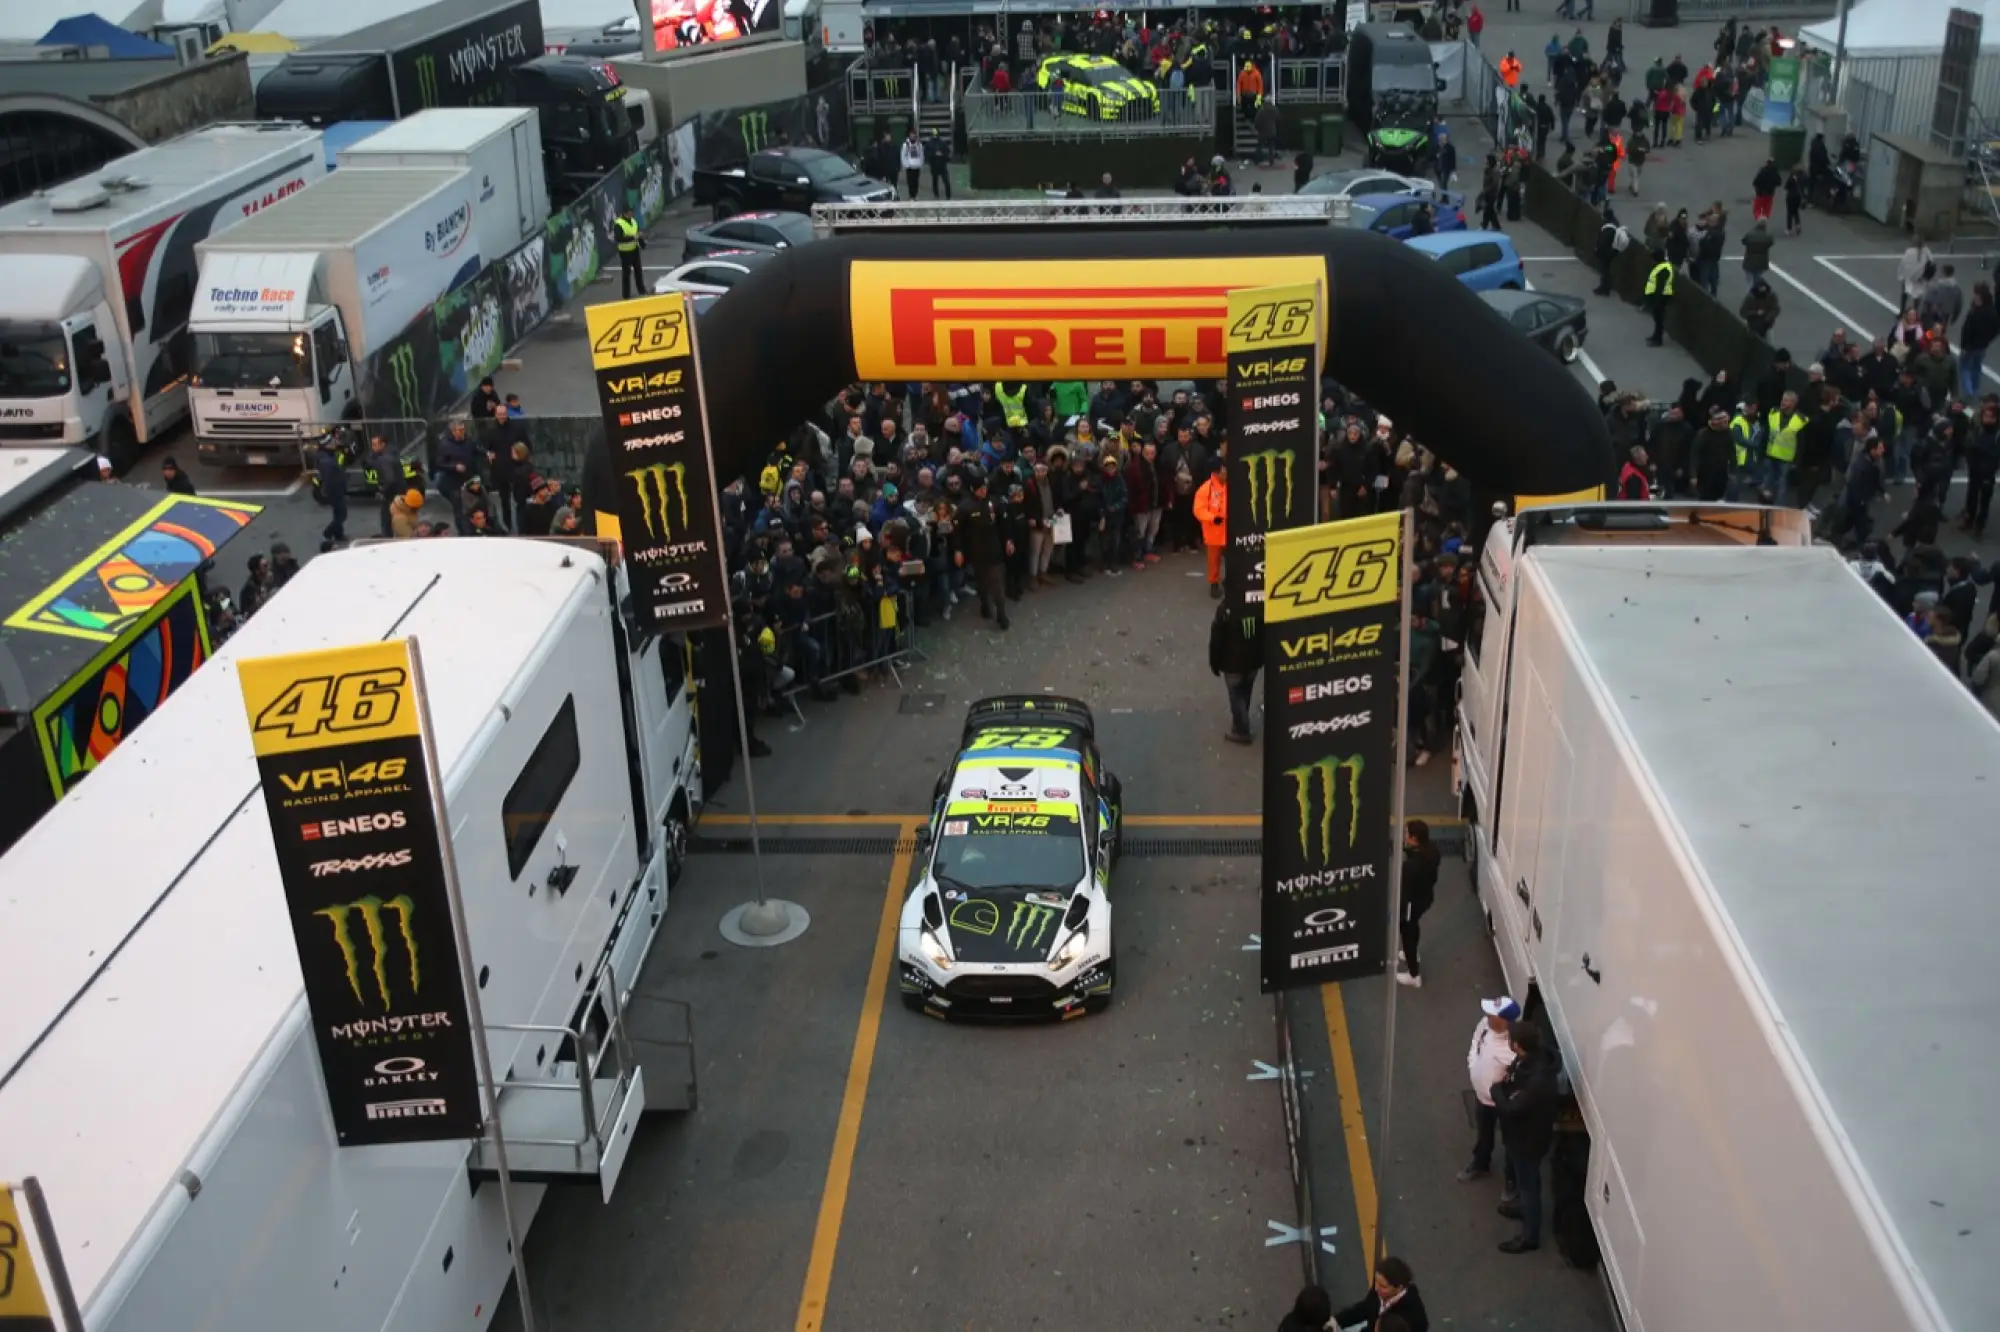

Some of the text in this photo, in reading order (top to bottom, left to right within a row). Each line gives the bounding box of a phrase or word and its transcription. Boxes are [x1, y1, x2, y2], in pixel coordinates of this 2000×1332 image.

[449, 24, 527, 85] MONSTER
[211, 287, 296, 302] Techno Race
[260, 304, 284, 312] rent
[1230, 299, 1314, 342] 46
[594, 311, 683, 358] 46
[890, 286, 1227, 367] PIRELL
[235, 403, 273, 412] BIANCHI
[1253, 392, 1301, 410] ENEOS
[631, 404, 682, 425] ENEOS
[633, 540, 708, 562] MONSTER
[1269, 539, 1396, 607] 46
[652, 582, 700, 596] OAKLEY
[654, 600, 705, 619] PIRELLI
[1279, 648, 1382, 673] RACING APPAREL
[1305, 674, 1373, 701] ENEOS
[253, 667, 407, 739] 46
[1288, 710, 1371, 739] TRAXXAS
[283, 783, 413, 808] RACING APPAREL
[321, 810, 407, 839] ENEOS
[309, 849, 413, 878] TRAXXAS
[1277, 863, 1376, 894] MONSTER
[1293, 919, 1357, 939] OAKLEY
[1290, 942, 1359, 969] PIRELLI
[330, 1011, 453, 1040] MONSTER
[363, 1071, 439, 1087] OAKLEY
[365, 1098, 446, 1121] PIRELLI
